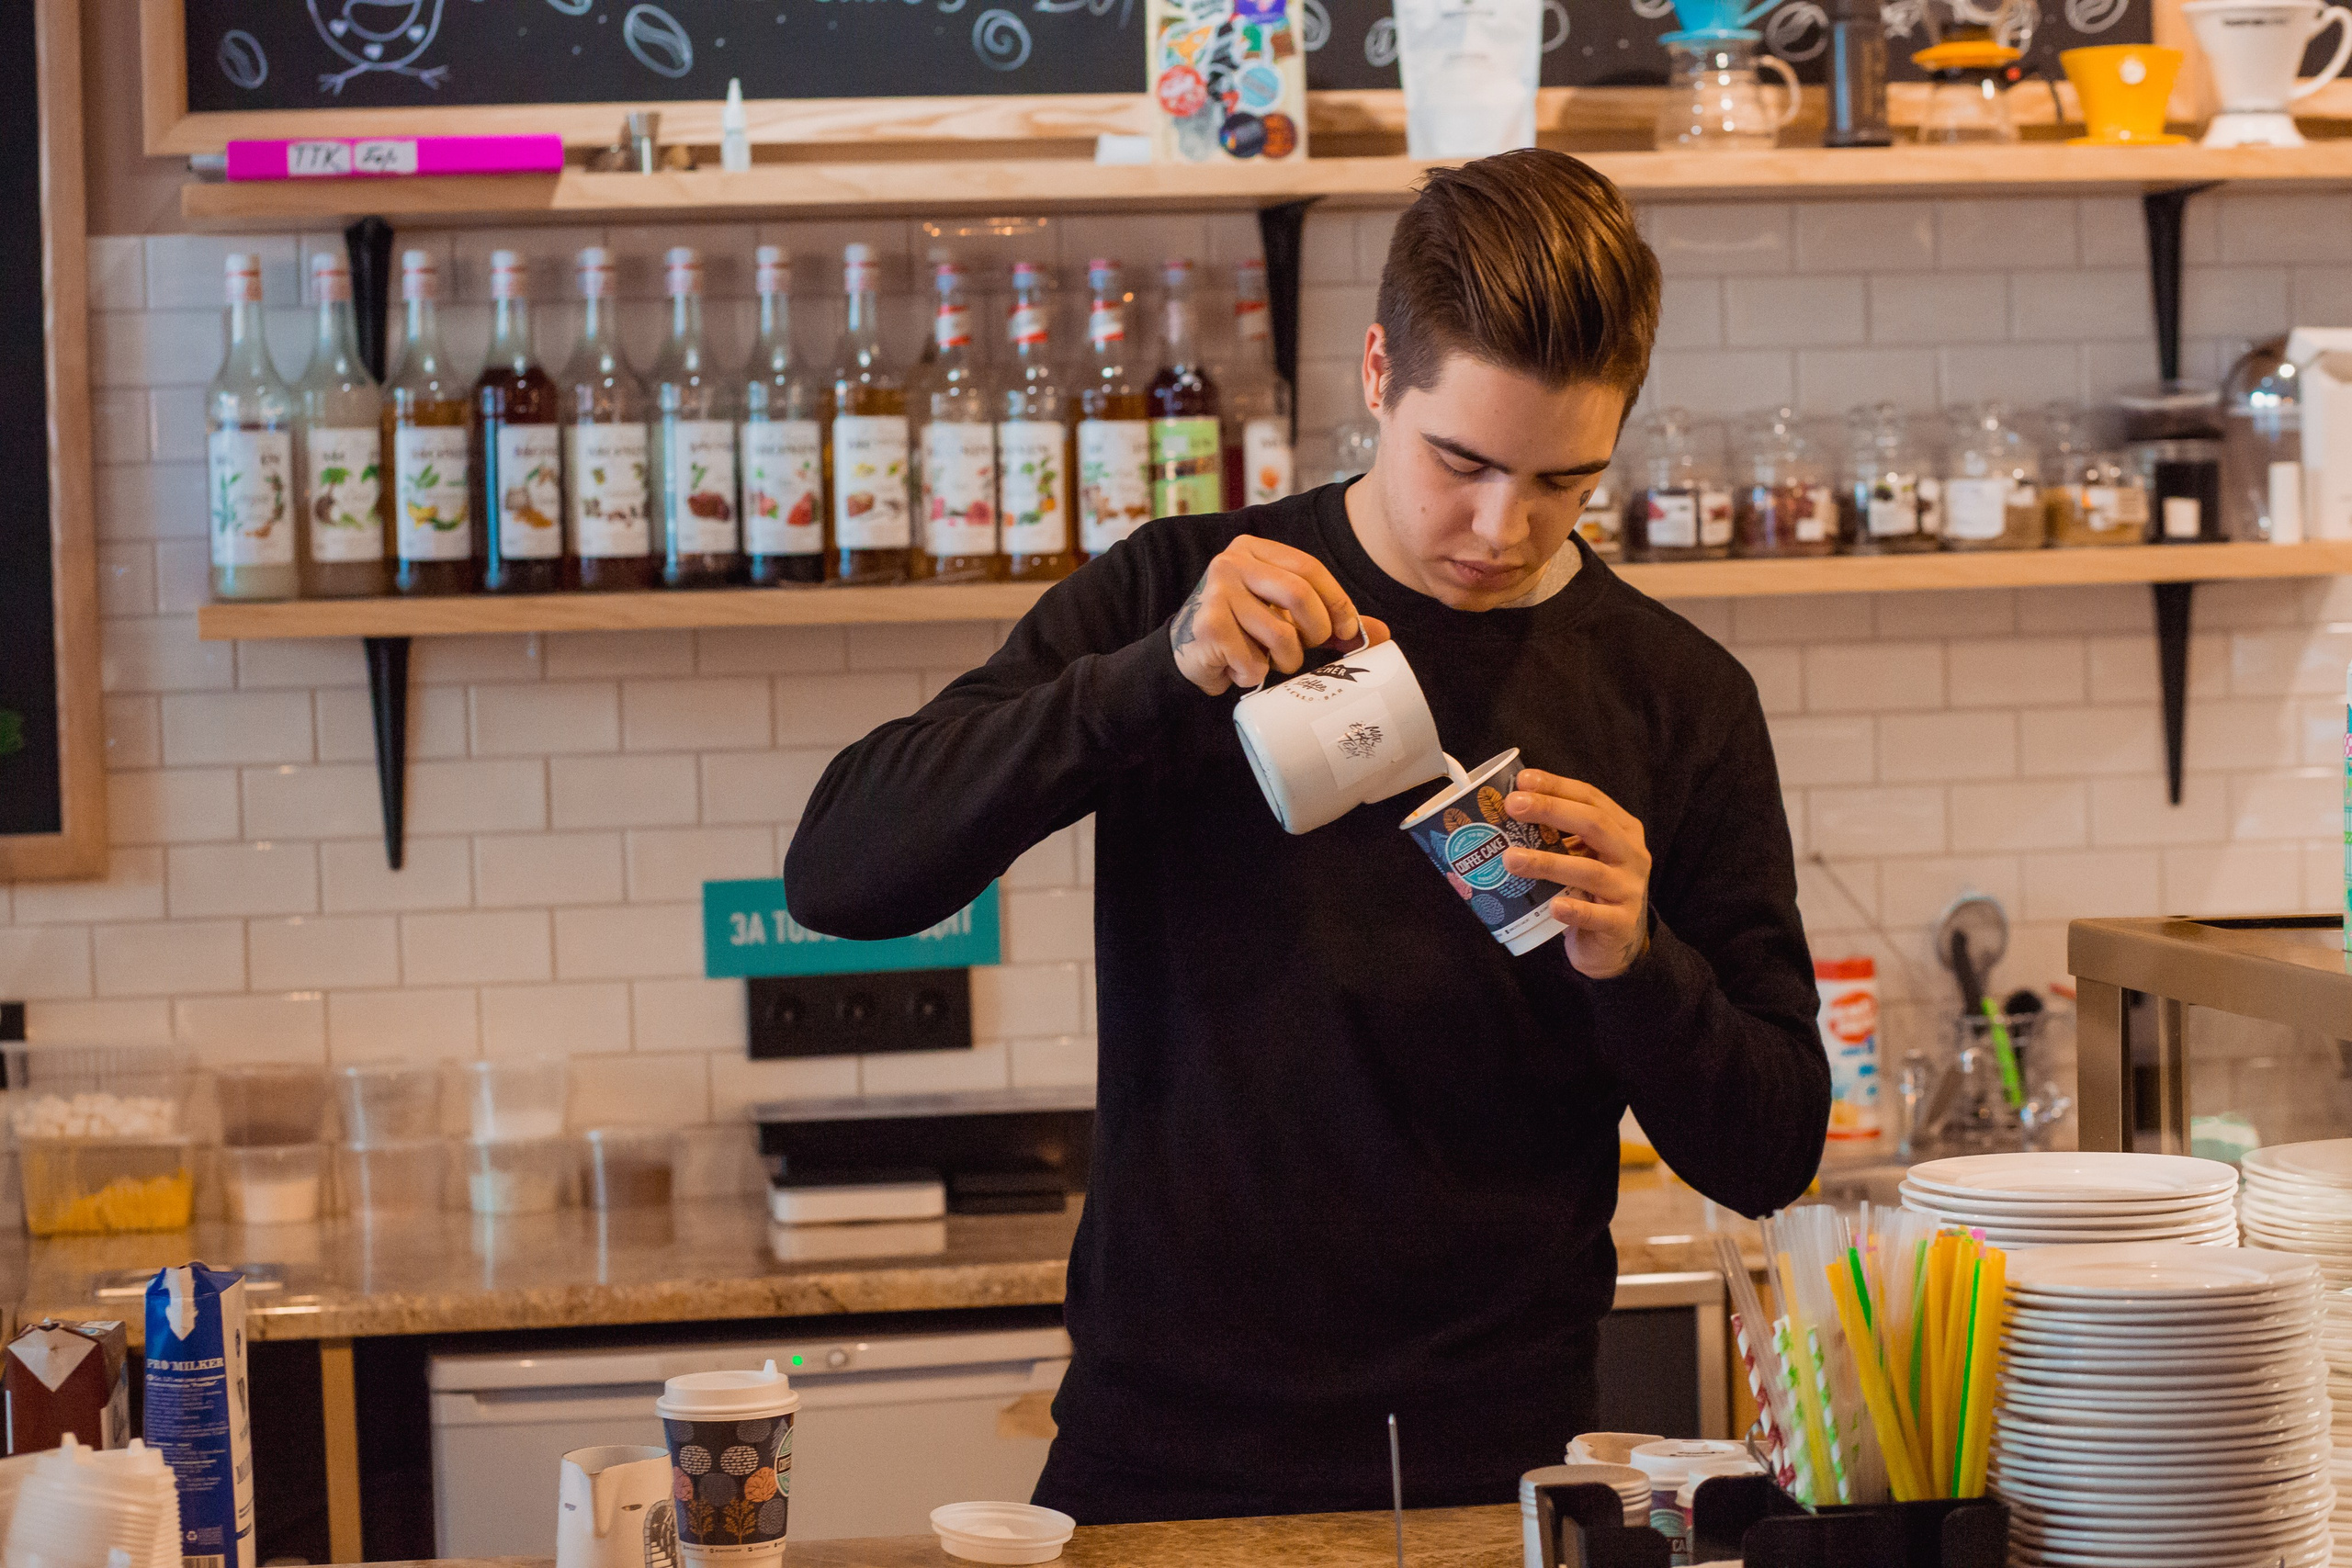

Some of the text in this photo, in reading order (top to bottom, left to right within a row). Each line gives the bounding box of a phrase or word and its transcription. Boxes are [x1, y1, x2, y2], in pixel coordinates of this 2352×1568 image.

[1454, 851, 1485, 874] COFFEE
[1480, 837, 1506, 859] CAKE
[146, 1357, 224, 1371] PRO MILKER
